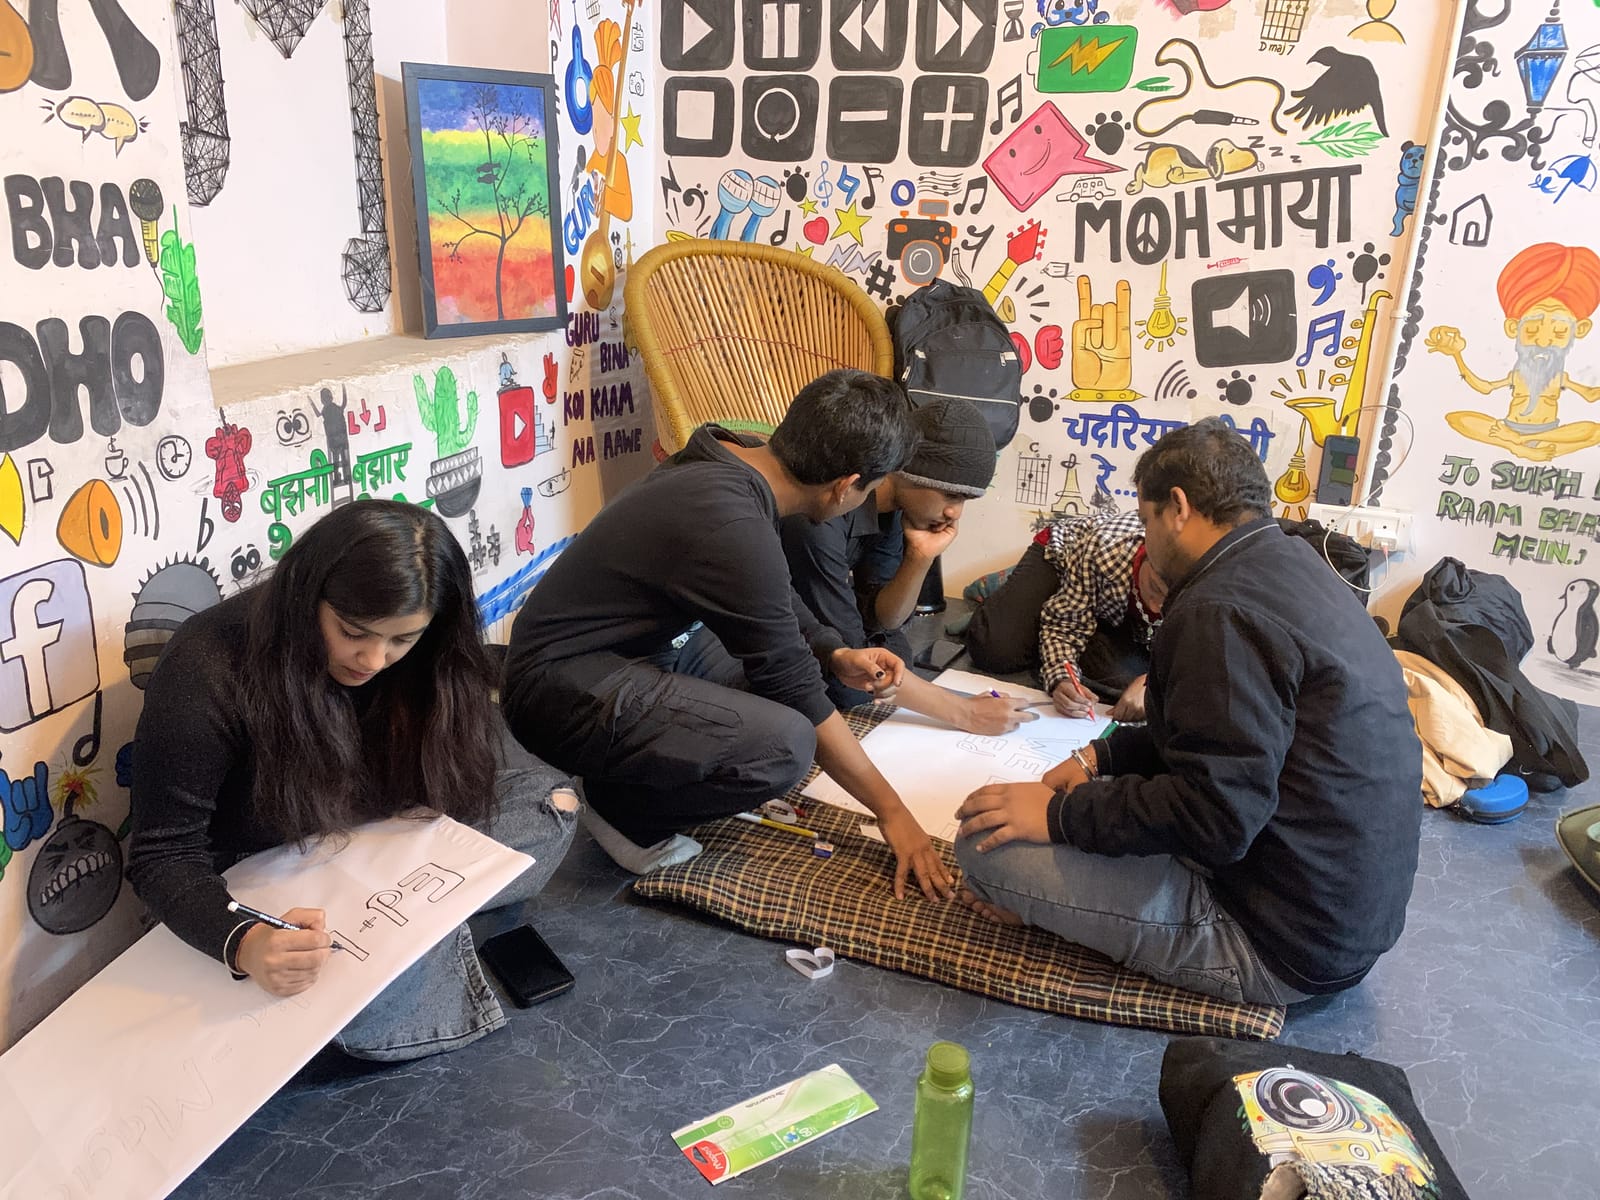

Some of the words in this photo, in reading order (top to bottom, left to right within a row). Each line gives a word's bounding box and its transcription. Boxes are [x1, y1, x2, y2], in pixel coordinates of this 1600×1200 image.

[1286, 44, 1295, 56] 7
[565, 310, 600, 348] GURU
[600, 341, 630, 374] BINA
[563, 389, 585, 426] KOI
[590, 380, 635, 422] KAAM
[572, 436, 596, 469] NA
[603, 427, 642, 461] AAWE
[1438, 454, 1480, 486] JO
[1491, 460, 1585, 501] SUKH
[1436, 490, 1522, 528] RAAM
[1538, 506, 1600, 543] BHA
